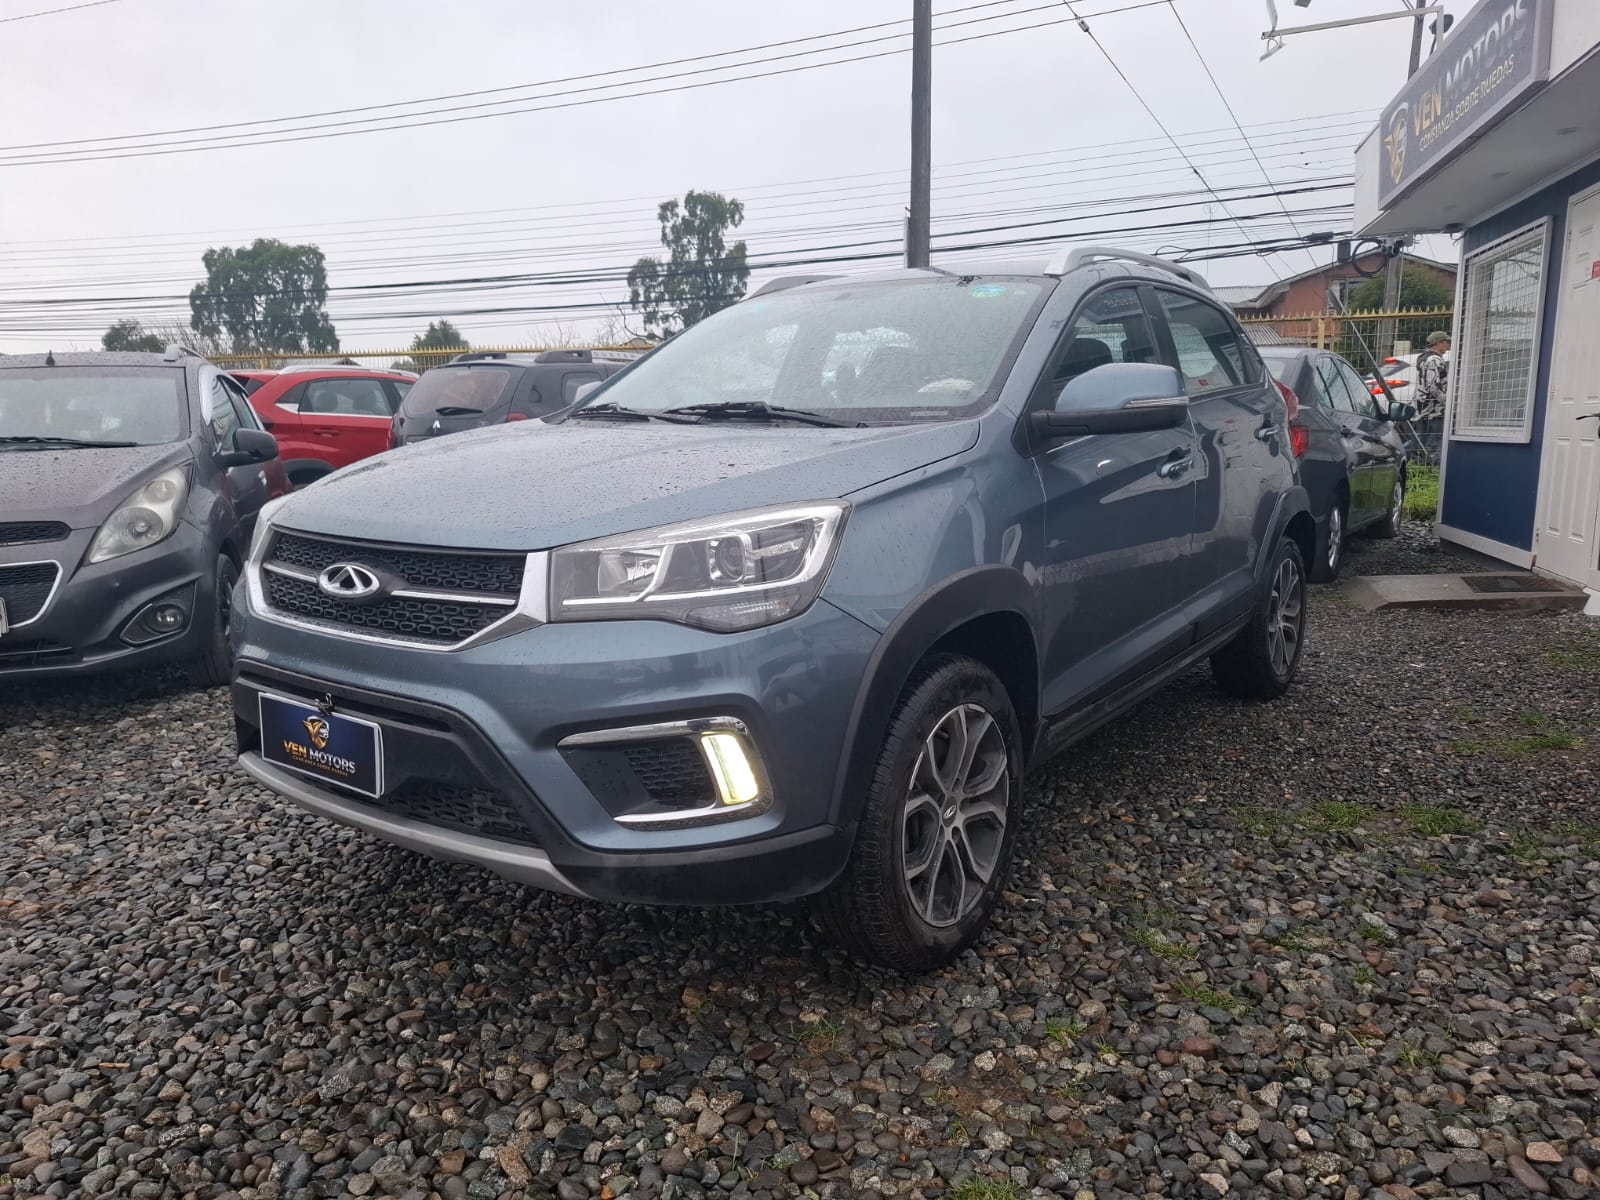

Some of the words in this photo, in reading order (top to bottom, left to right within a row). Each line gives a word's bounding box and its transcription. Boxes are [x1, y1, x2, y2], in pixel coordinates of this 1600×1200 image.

[1413, 78, 1442, 136] VEN
[1445, 0, 1528, 107] MOTORS
[1420, 111, 1455, 151] CONFIANZA
[1456, 85, 1480, 121] SOBRE
[1481, 54, 1515, 97] RUEDAS
[284, 739, 307, 758] VEN
[309, 747, 356, 774] MOTORS
